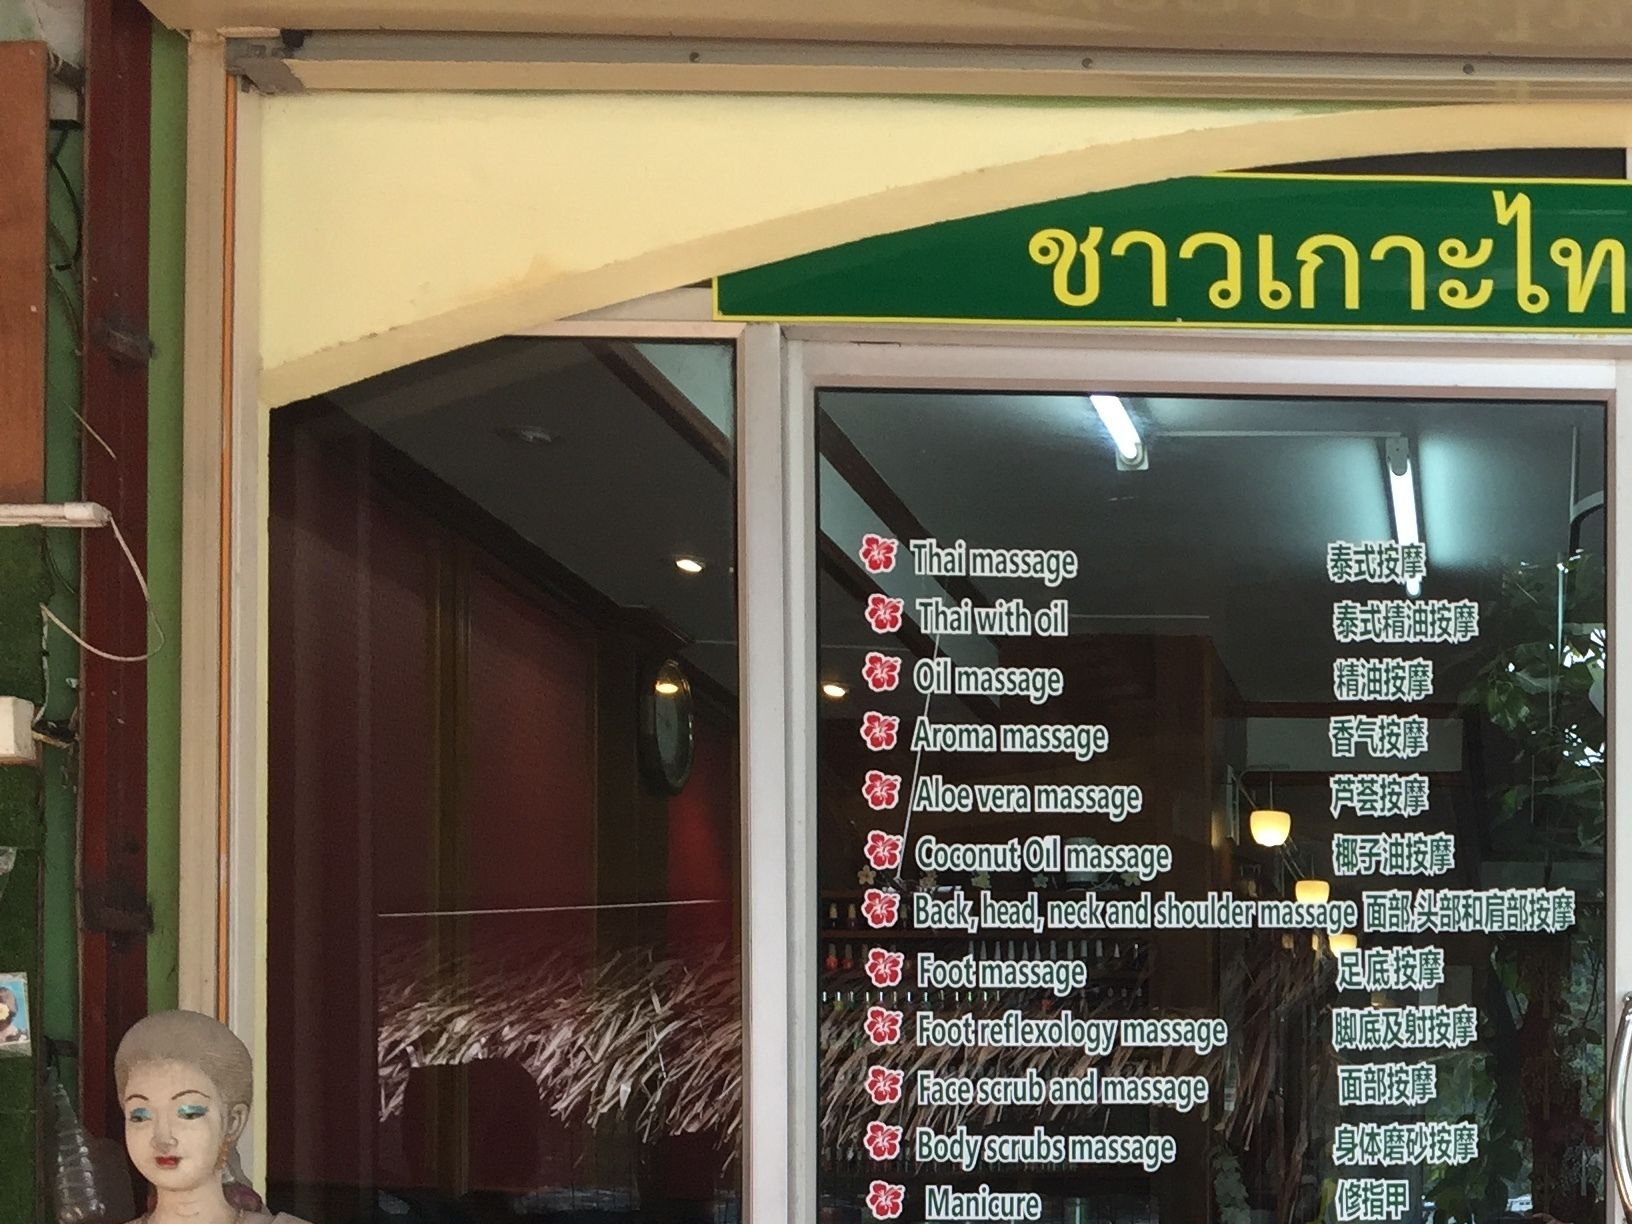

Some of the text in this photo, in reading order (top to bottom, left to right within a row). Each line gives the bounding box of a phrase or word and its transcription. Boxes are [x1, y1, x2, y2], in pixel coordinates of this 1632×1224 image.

[911, 540, 1078, 586] Thai massage
[1327, 540, 1426, 584] 泰式按摩
[918, 599, 1069, 637] Thai with oil
[1332, 599, 1479, 644] 泰式精油按摩
[914, 658, 1064, 705] Oil massage
[1333, 657, 1434, 702] 精油按摩
[912, 720, 1108, 762] Aroma massage
[1329, 714, 1429, 759] 香气按摩
[913, 777, 1142, 822] Aloe vera massage
[1329, 772, 1429, 818] 芦荟按摩
[916, 834, 1172, 881] Coconut Oil massage
[1331, 832, 1456, 877] 椰子油按摩
[912, 892, 1358, 936] Back, head, neck and shoulder massage
[916, 951, 1088, 997] Foot massage
[1336, 945, 1445, 991] 足底按摩
[916, 1011, 1228, 1058] Foot reflexology massage
[916, 1069, 1209, 1114] Face scrub and massage
[1339, 1061, 1437, 1106] 面部按摩
[916, 1129, 1176, 1172] Body scrubs massage
[1332, 1121, 1478, 1168] 身体磨砂按摩
[925, 1185, 1042, 1222] Manicure
[1336, 1179, 1410, 1224] 修指甲
